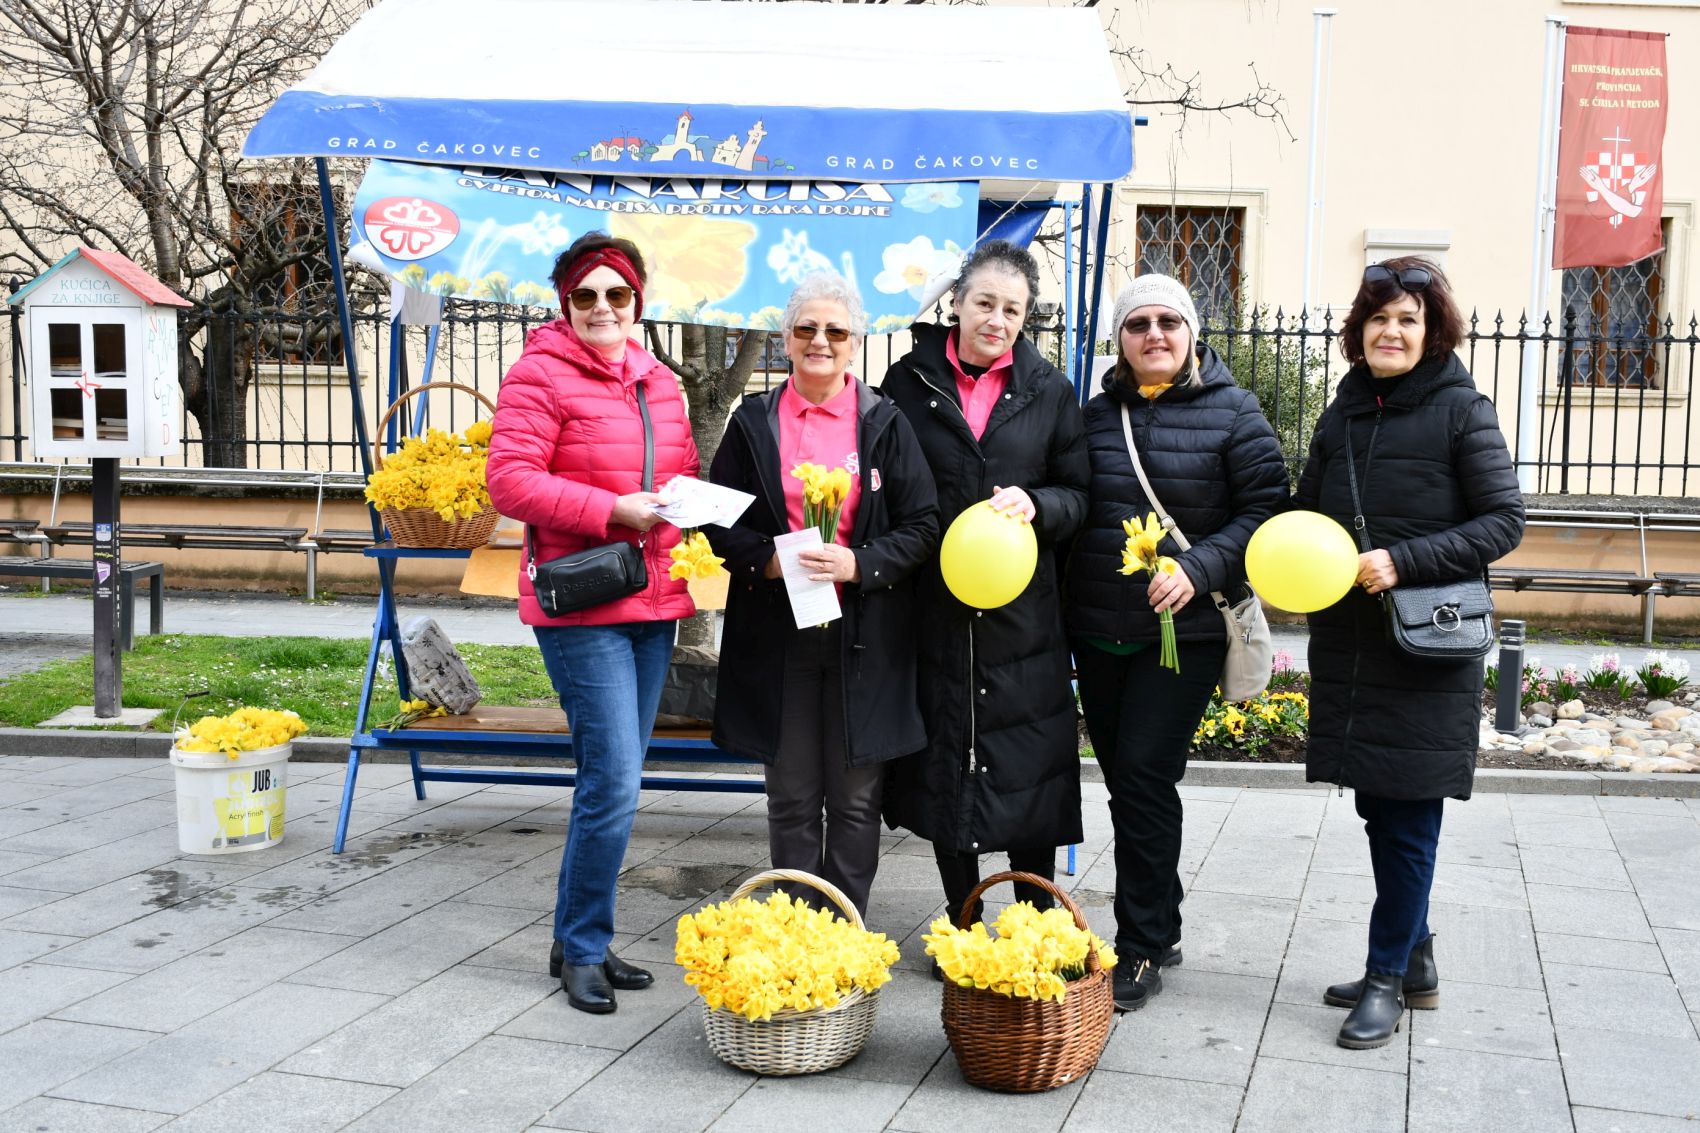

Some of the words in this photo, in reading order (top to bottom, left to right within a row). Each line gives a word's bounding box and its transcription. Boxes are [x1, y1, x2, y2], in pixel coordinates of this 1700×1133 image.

[1611, 66, 1664, 77] FRANJEVAČK
[328, 137, 397, 149] GRAD
[416, 141, 541, 159] ČAKOVEC
[826, 155, 894, 170] GRAD
[914, 155, 1039, 170] ČAKOVEC
[457, 177, 561, 203] CVJETOM
[565, 196, 661, 214] NARCISA
[665, 203, 749, 215] PROTIV
[752, 204, 813, 215] RAKA
[818, 204, 891, 217] DOJKE
[60, 278, 112, 290] KUĆICA
[52, 293, 69, 304] ZA
[74, 293, 121, 304] KNJIGE
[251, 768, 271, 793] JUB
[229, 812, 247, 820] Acry
